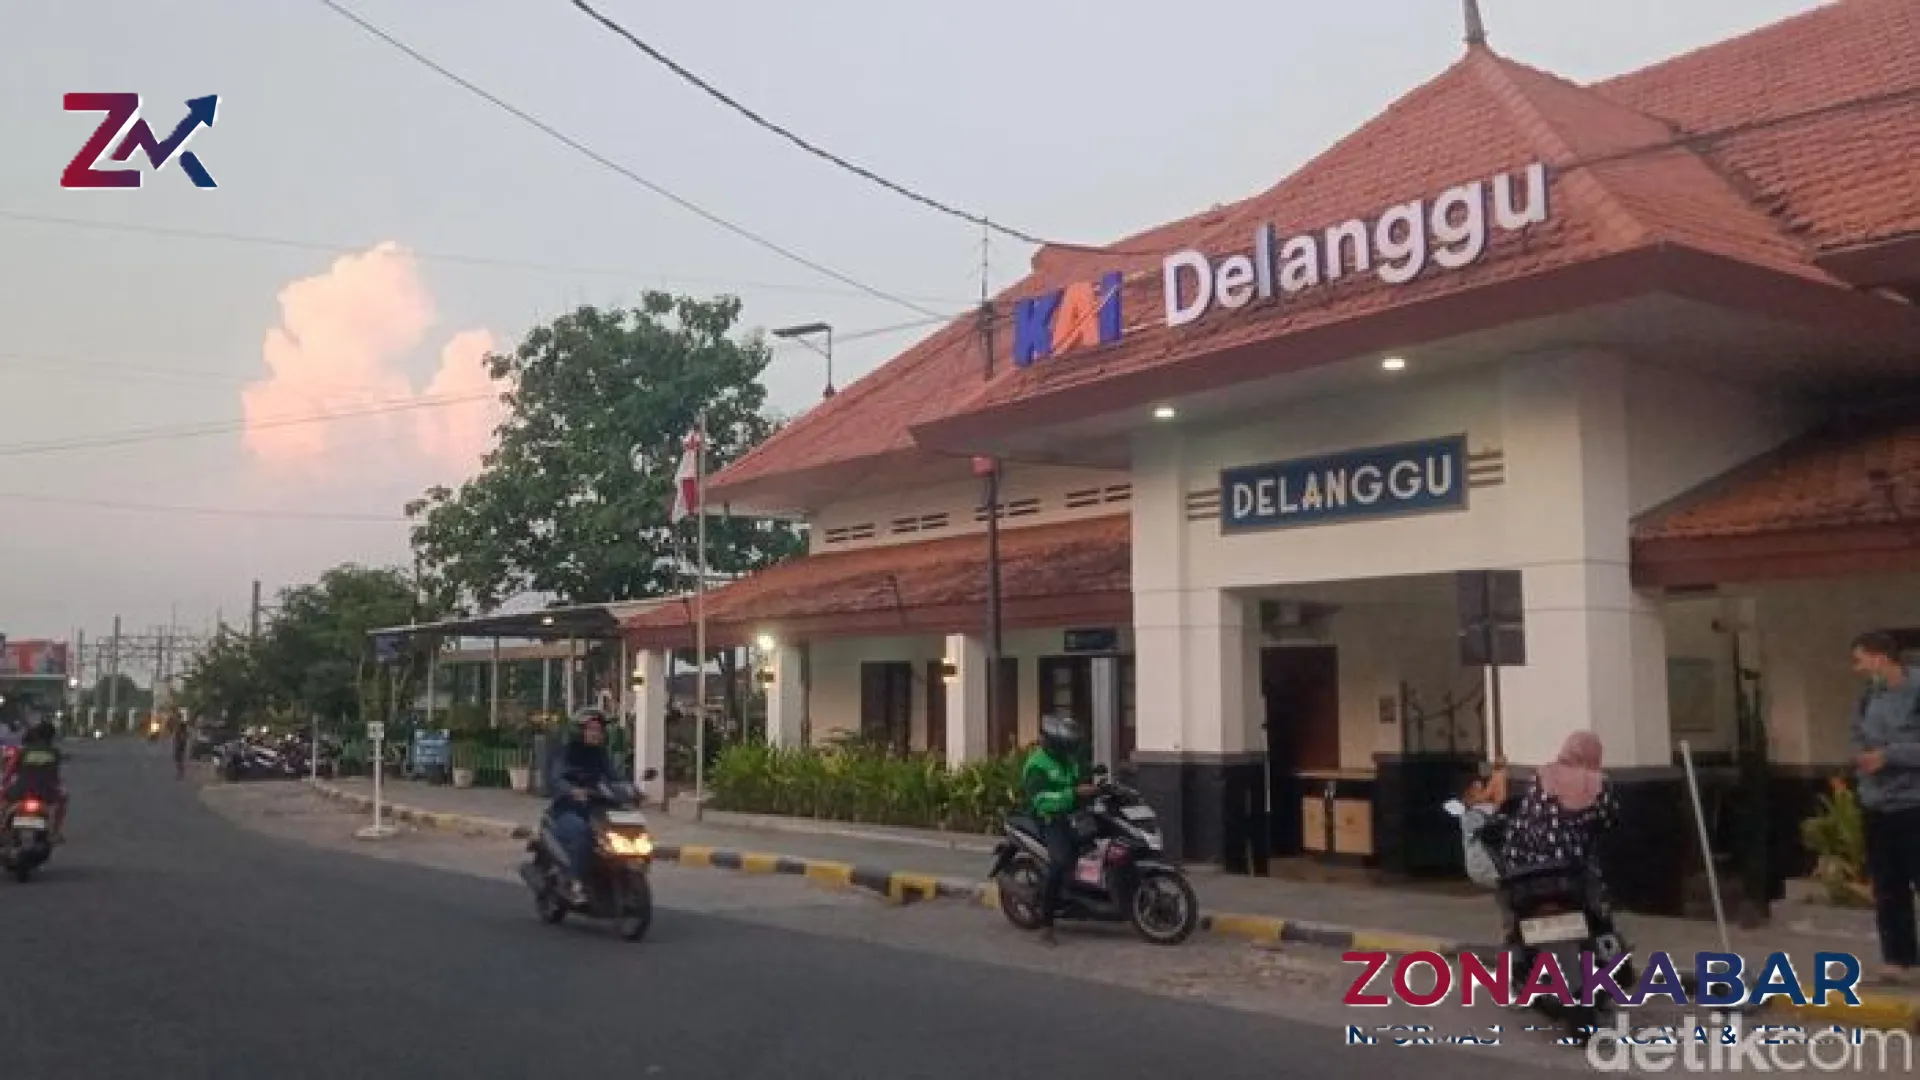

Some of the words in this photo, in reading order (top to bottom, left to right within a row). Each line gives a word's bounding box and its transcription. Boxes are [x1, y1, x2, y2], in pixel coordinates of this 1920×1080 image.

[1012, 270, 1123, 367] KAI
[1162, 162, 1548, 328] Delanggu
[1233, 454, 1452, 520] DELANGGU
